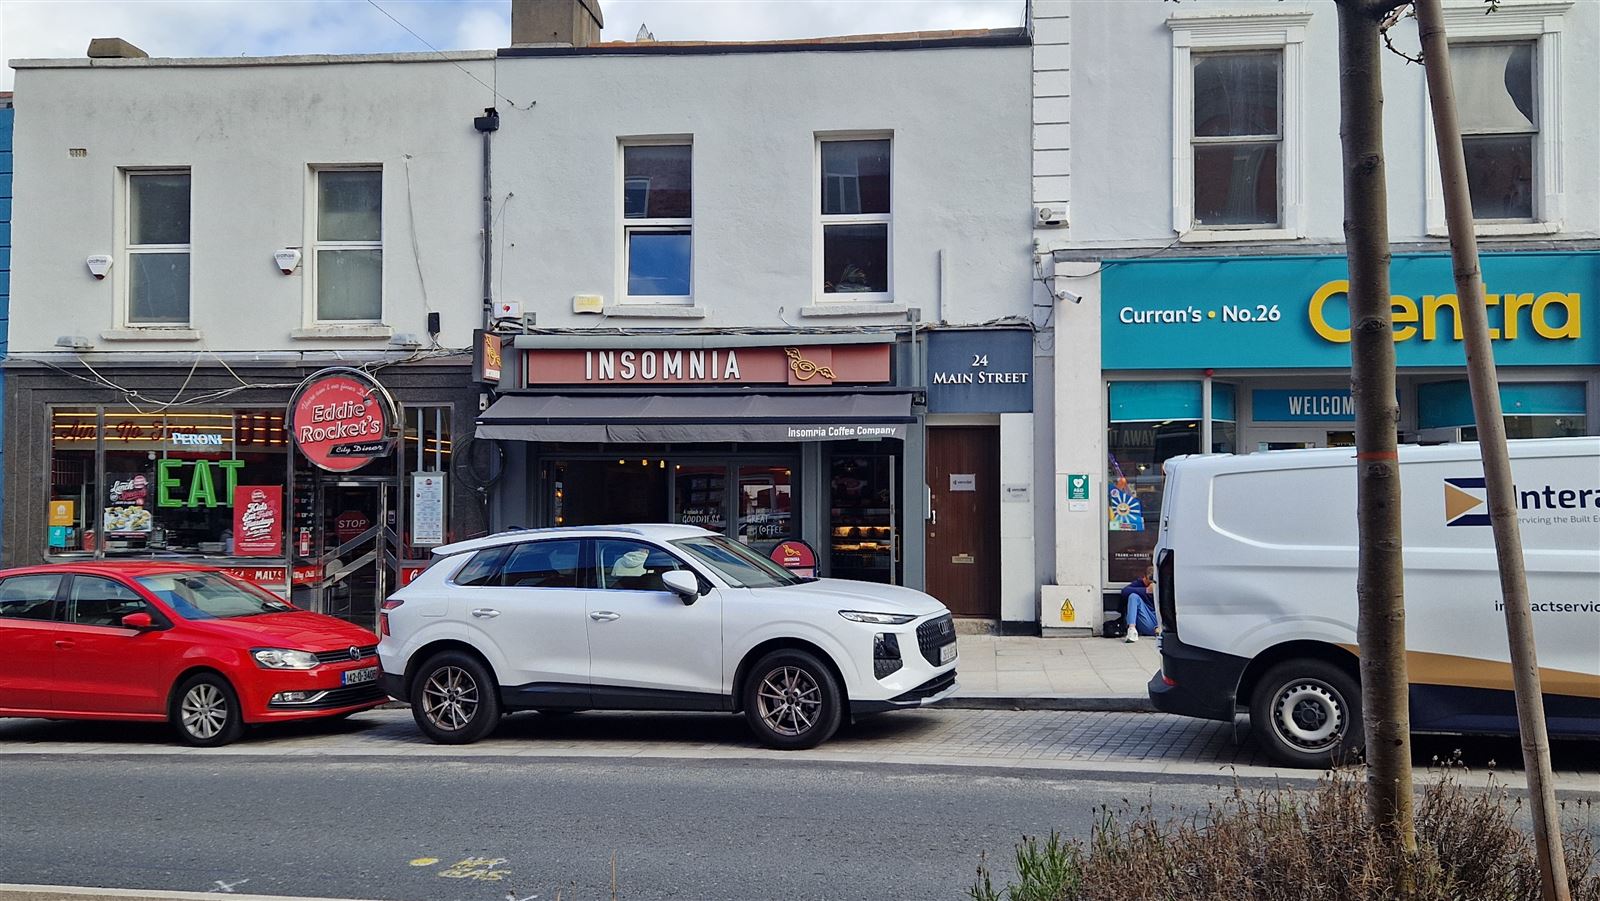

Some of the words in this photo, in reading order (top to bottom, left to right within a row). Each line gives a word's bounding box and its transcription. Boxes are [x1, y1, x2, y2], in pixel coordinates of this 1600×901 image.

[1119, 305, 1202, 325] Curran's
[1222, 305, 1281, 323] No.26
[585, 351, 741, 380] INSOMNIA
[972, 354, 989, 367] 24
[932, 372, 973, 384] MAIN
[978, 371, 1029, 384] STREET
[312, 401, 366, 423] Eddie
[1288, 396, 1354, 415] WELCOM
[300, 416, 380, 444] Rocket's
[828, 426, 855, 436] Coffee
[856, 426, 897, 437] Company
[172, 432, 222, 445] PERONI
[1123, 430, 1156, 446] AWAY
[335, 446, 351, 454] City
[352, 444, 383, 453] Diner
[158, 459, 244, 508] EAT
[1513, 484, 1600, 510] Inter
[338, 520, 366, 528] STOP
[682, 514, 721, 523] GOODNESS
[746, 514, 770, 524] GREAT
[1518, 516, 1552, 525] ervicing
[1570, 515, 1590, 523] Built
[758, 525, 784, 535] COFFEE
[255, 570, 282, 580] MALTS
[1494, 600, 1600, 613] inactservic
